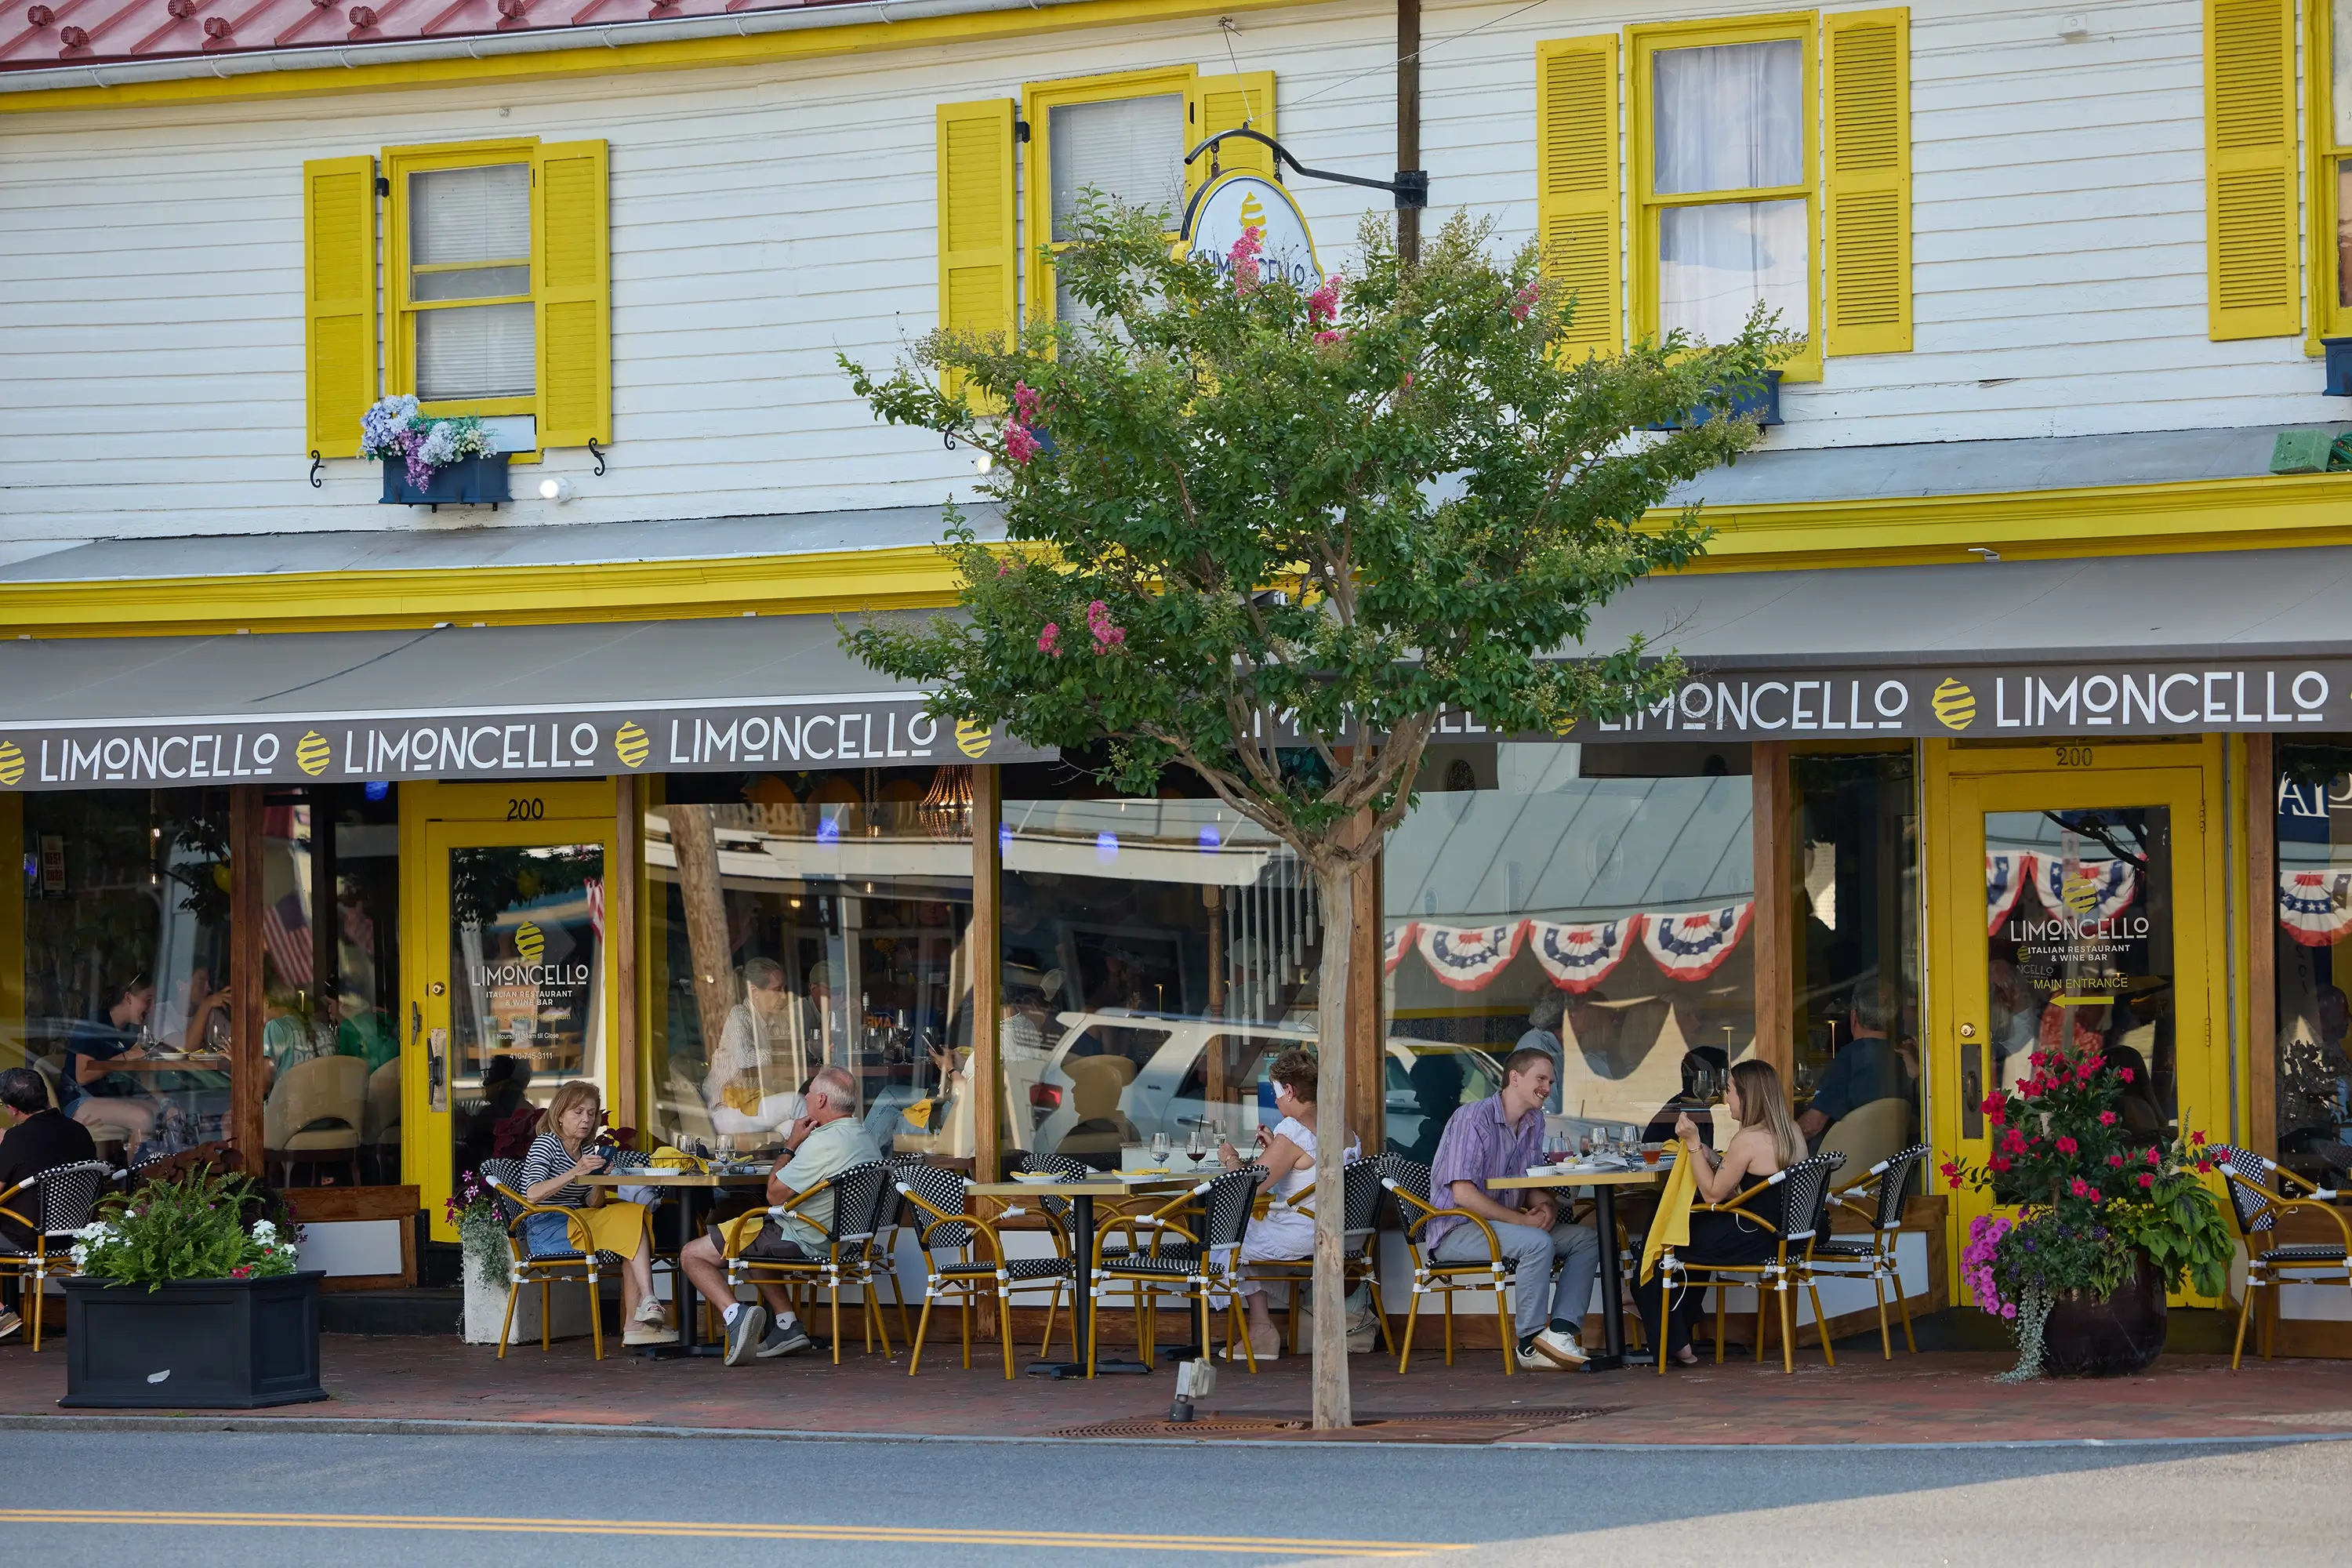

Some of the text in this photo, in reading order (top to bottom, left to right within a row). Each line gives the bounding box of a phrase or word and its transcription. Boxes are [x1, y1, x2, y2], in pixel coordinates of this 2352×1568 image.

[1997, 670, 2328, 728] LIMONCELLO
[345, 723, 598, 774] LIMONCELLO
[670, 712, 937, 764] LIMONCELLO
[41, 733, 280, 782] LIMONCELLO
[2056, 747, 2093, 767] 200
[506, 797, 544, 822] 200
[2010, 916, 2149, 942] LIMONCELLO
[2028, 944, 2130, 954] ITALIAN RESTAURANT
[472, 964, 589, 986] LIMONCELLO
[2016, 964, 2054, 976] NCELLO
[2034, 979, 2062, 989] MAIN
[2065, 978, 2129, 989] ENTRANCE
